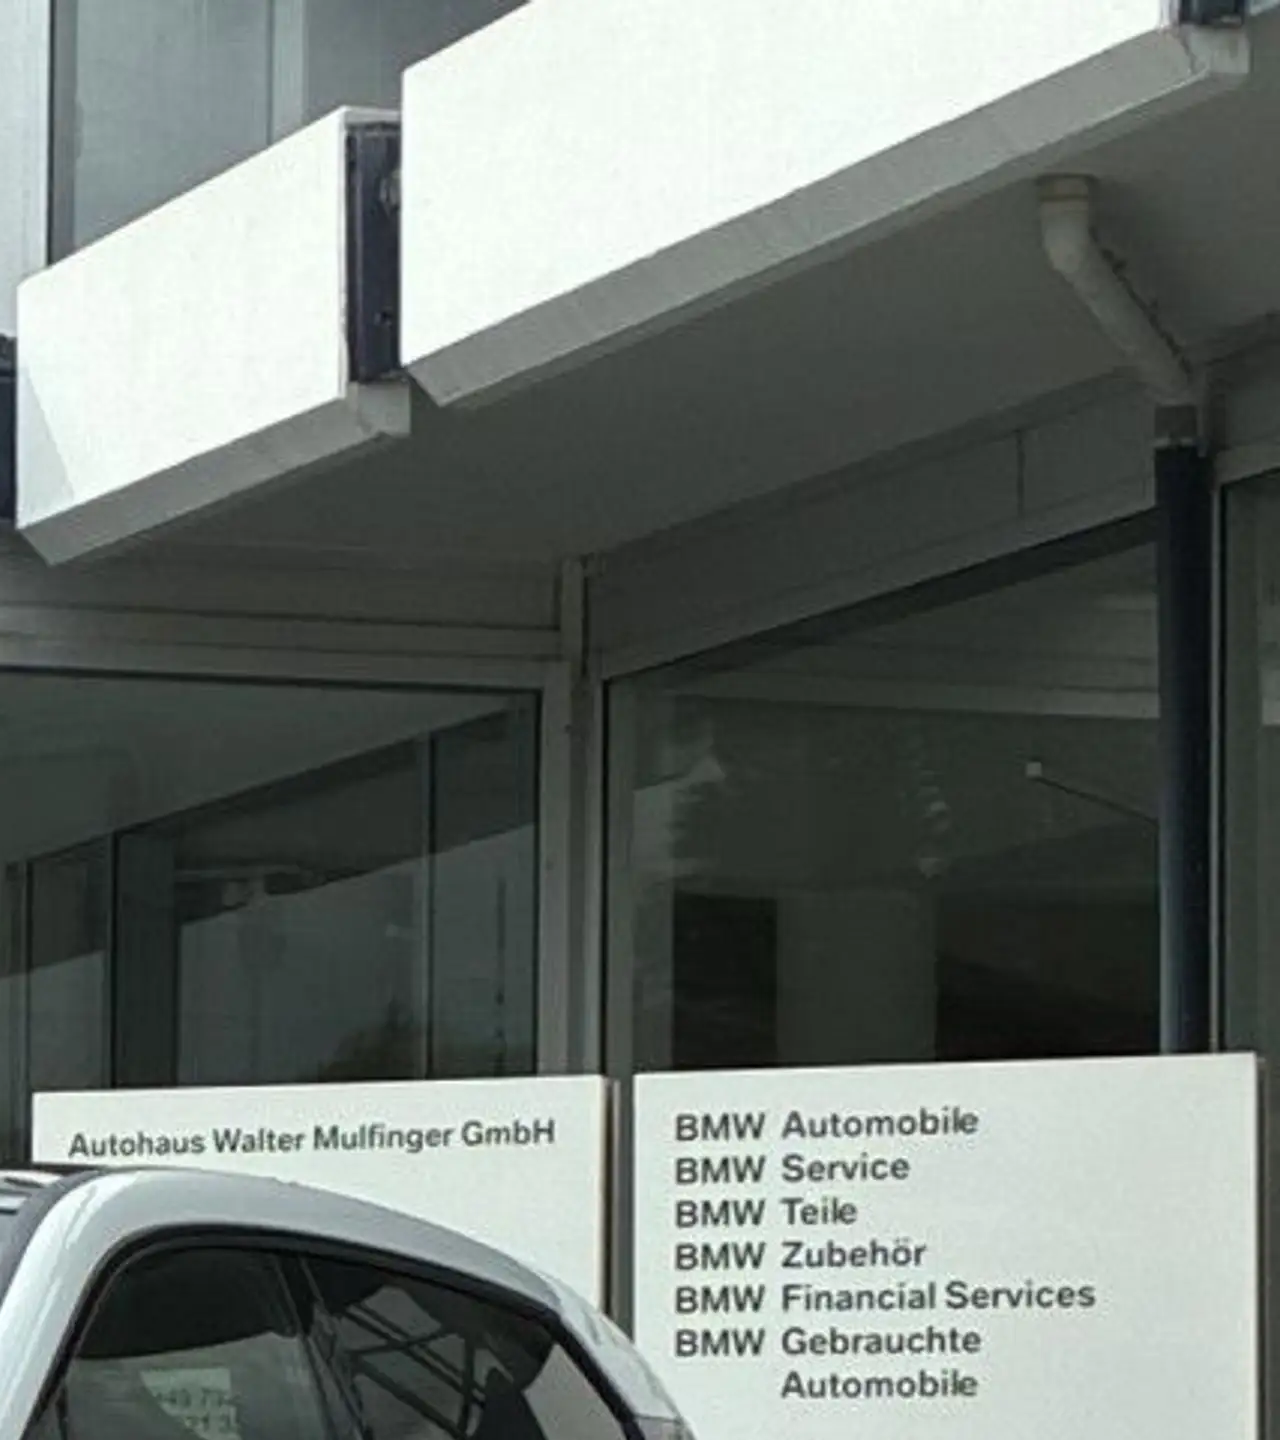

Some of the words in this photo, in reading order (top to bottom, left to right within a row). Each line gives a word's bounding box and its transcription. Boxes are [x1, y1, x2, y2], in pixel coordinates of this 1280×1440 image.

[68, 1130, 207, 1159] Autohaus
[213, 1126, 306, 1154] Walter
[313, 1122, 455, 1155] Mulfinger
[461, 1117, 556, 1148] GmbH
[674, 1111, 767, 1143] BMW
[780, 1105, 981, 1140] Automobile
[674, 1154, 767, 1186] BMW
[781, 1151, 912, 1184] Service
[674, 1197, 767, 1229] BMW
[779, 1195, 859, 1226] Teile
[674, 1240, 767, 1272] BMW
[780, 1236, 928, 1270] Zubehör
[674, 1283, 767, 1315] BMW
[781, 1279, 937, 1314] Financial
[944, 1278, 1098, 1311] Services
[674, 1327, 767, 1358] BMW
[781, 1323, 983, 1357] Gebrauchte
[780, 1368, 980, 1400] Automobile
